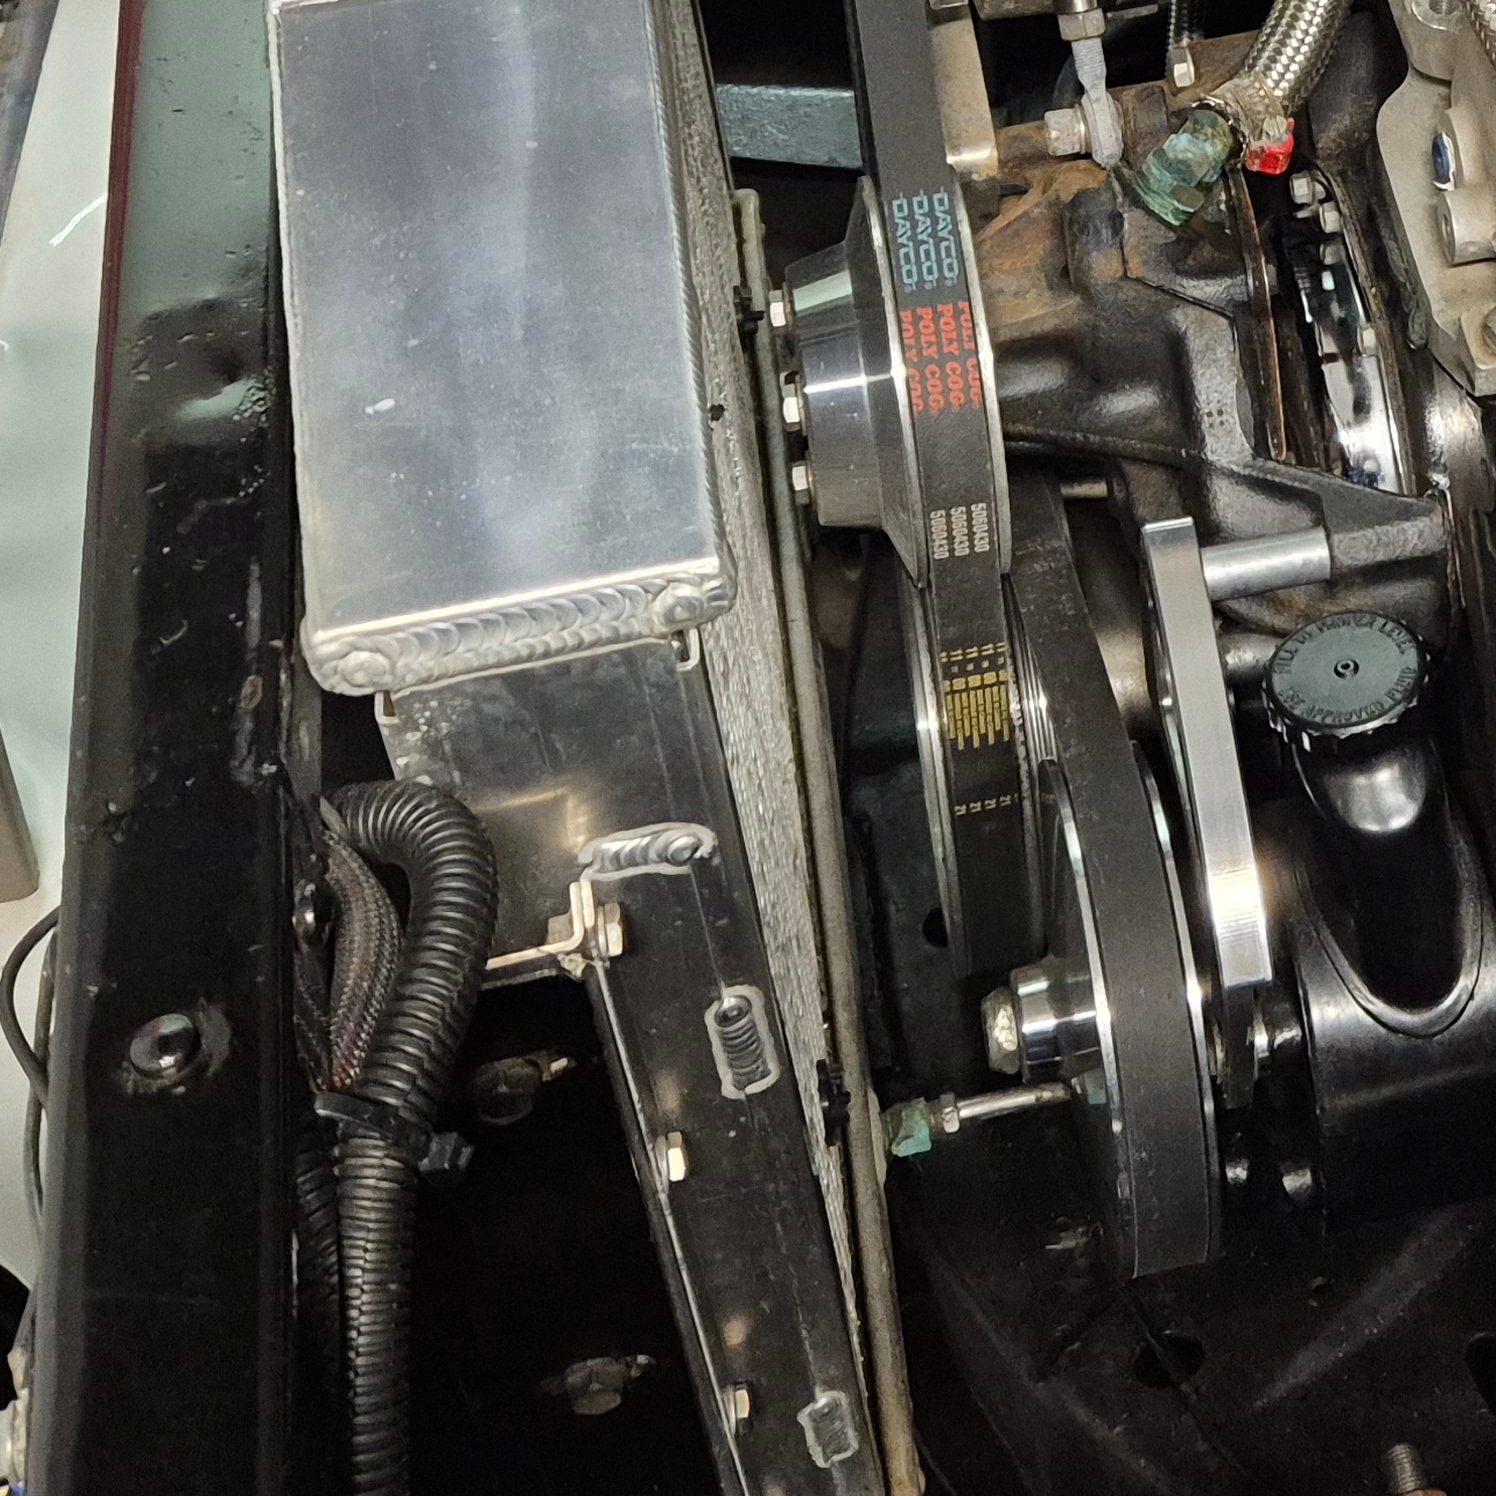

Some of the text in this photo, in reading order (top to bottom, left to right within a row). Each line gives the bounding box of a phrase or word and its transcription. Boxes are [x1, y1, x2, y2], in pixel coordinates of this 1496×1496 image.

[892, 192, 918, 292] DAYCO
[912, 189, 939, 289] DAYCO
[932, 187, 959, 286] DAYCO
[917, 307, 945, 413] POLY COG
[937, 303, 966, 409] POLY COG
[930, 510, 949, 560] 5060430
[950, 506, 970, 557] 5060430
[971, 502, 990, 553] 5060430
